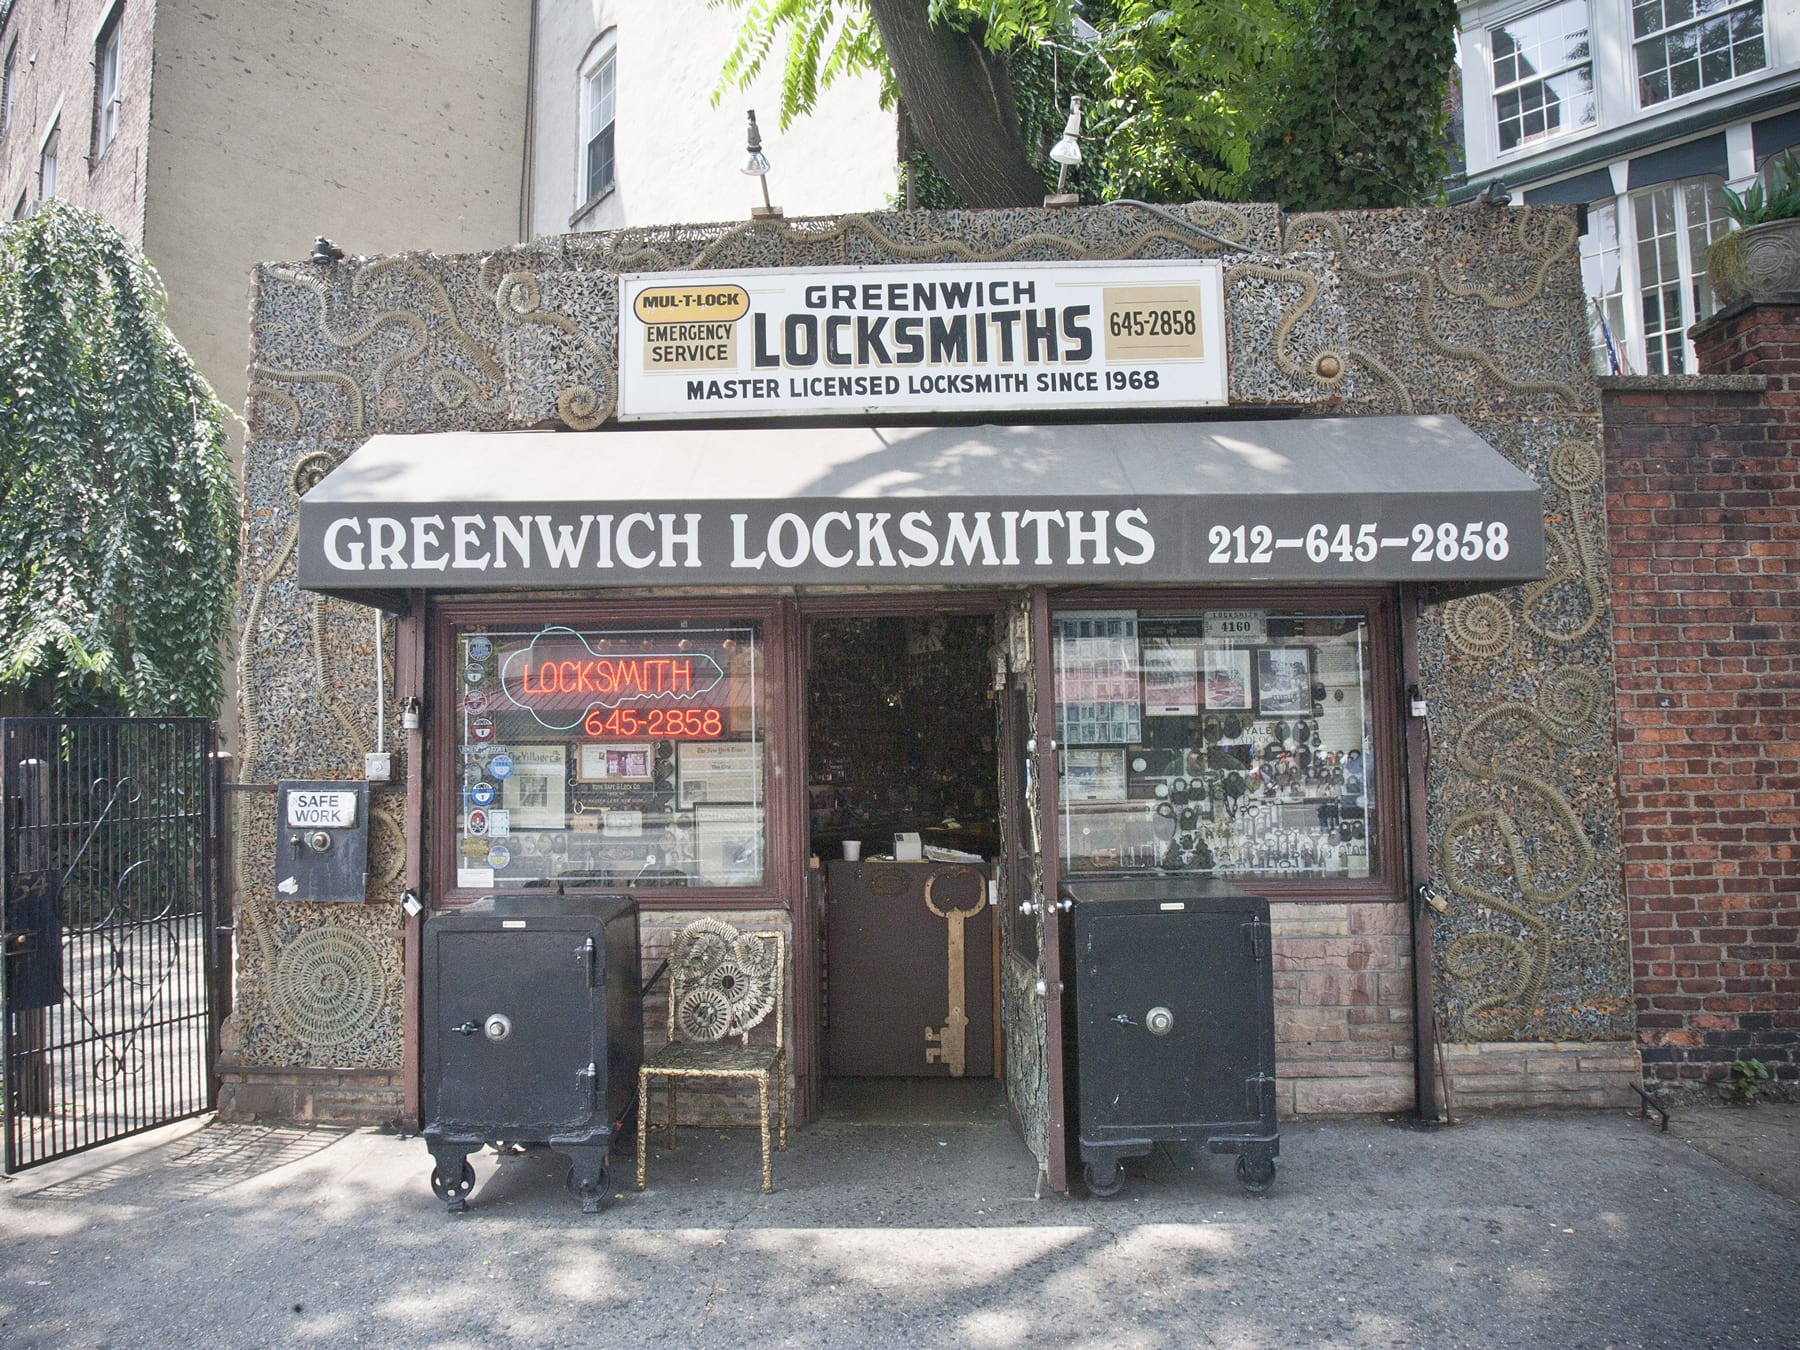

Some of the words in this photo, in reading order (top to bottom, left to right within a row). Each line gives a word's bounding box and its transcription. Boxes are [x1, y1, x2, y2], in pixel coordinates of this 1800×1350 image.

[643, 293, 740, 308] MUL-T-LOCK
[804, 281, 1036, 311] GREENWICH
[647, 324, 732, 342] EMERGENCY
[754, 304, 1093, 368] LOCKSMITHS
[1109, 309, 1197, 338] 645-2858
[652, 344, 728, 362] SERVICE
[687, 378, 780, 400] MASTER
[788, 375, 900, 398] LICENSED
[907, 372, 1030, 395] LOCKSMITH
[1037, 371, 1099, 392] SINCE
[1104, 370, 1160, 391] 1968
[323, 512, 702, 571] GREENWICH
[730, 508, 1155, 571] LOCKSMITHS
[1207, 521, 1509, 564] 212-645-2858
[1222, 621, 1251, 632] 4160
[523, 660, 692, 693] LOCKSMITH
[585, 709, 722, 736] 645-2858
[297, 795, 339, 808] SAFE
[295, 810, 341, 822] WORK
